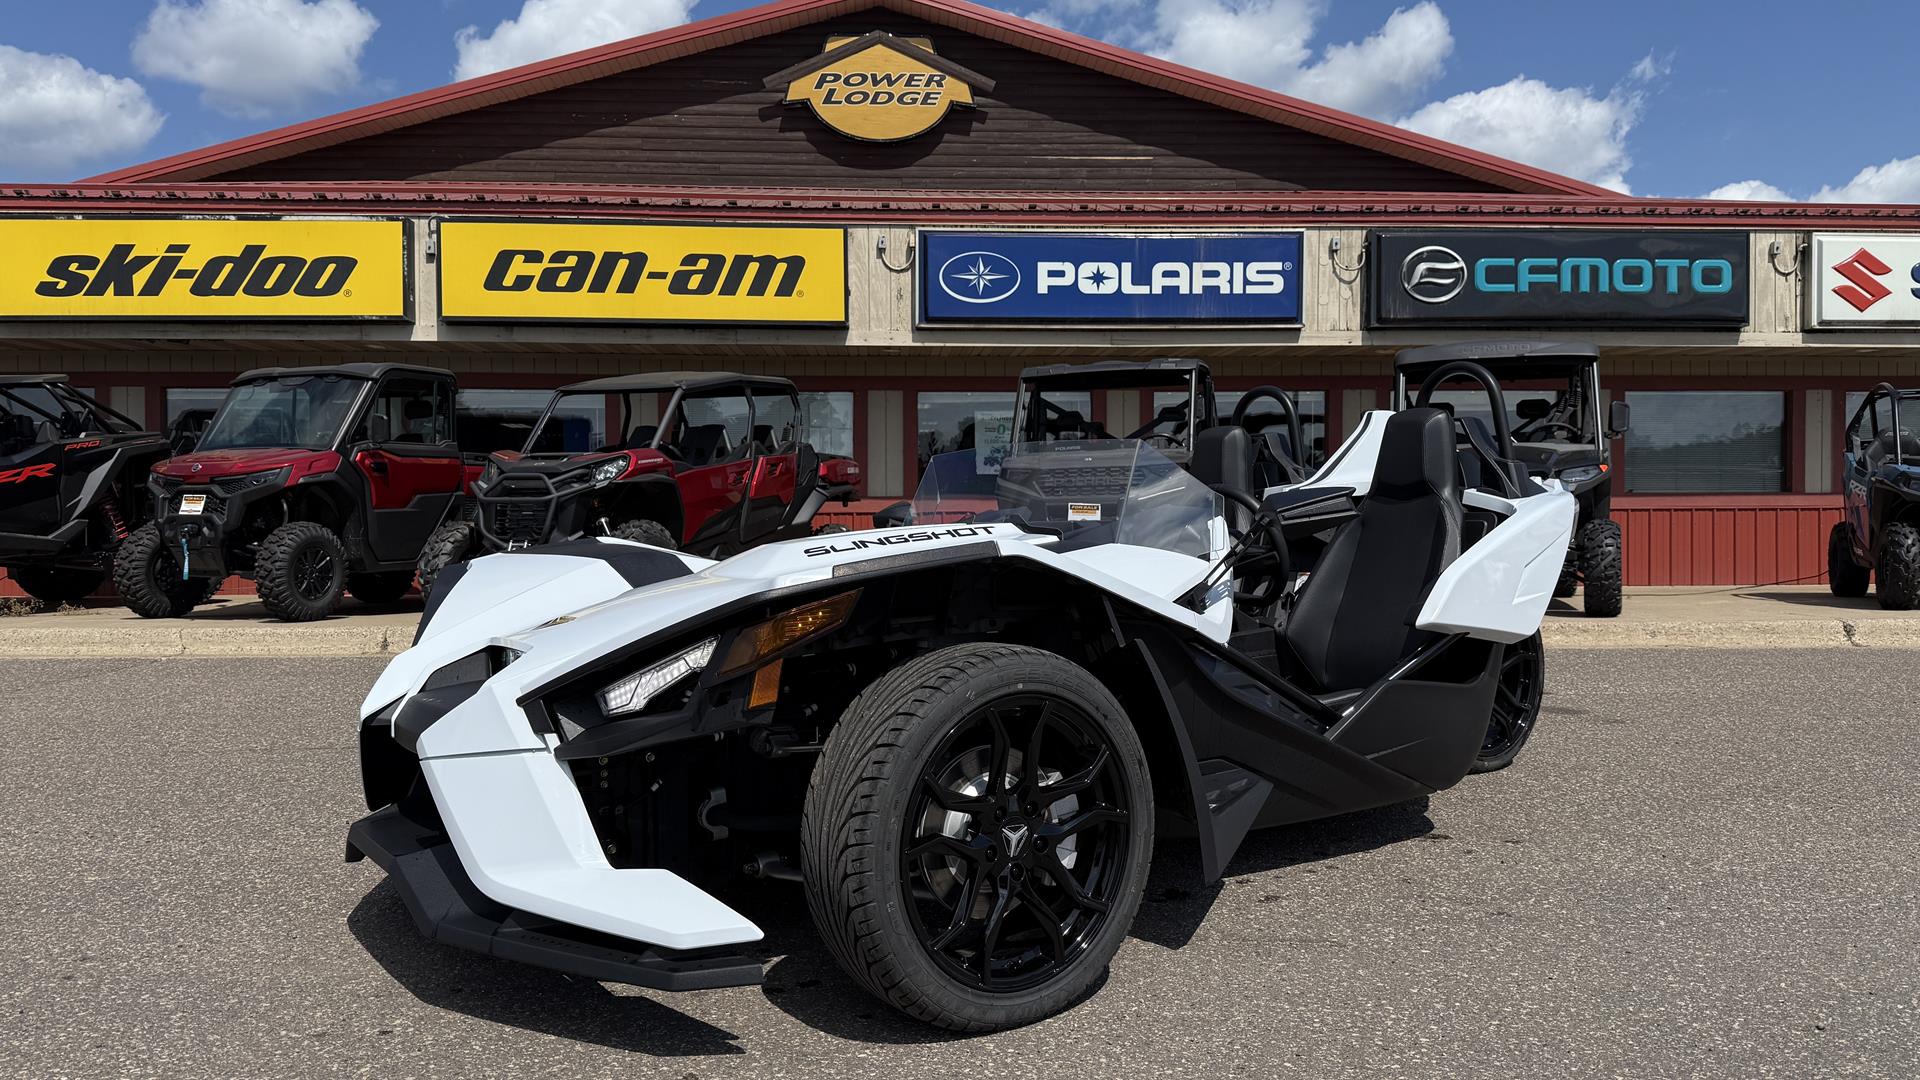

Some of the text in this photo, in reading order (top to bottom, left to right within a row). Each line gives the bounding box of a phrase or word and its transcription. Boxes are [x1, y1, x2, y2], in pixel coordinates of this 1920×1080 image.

[814, 72, 948, 90] POWER
[821, 88, 942, 106] LODGE
[35, 243, 358, 297] ski-doo
[483, 249, 806, 297] can-am
[1037, 261, 1285, 295] POLARIS
[1474, 257, 1733, 294] CFMOTO
[64, 440, 101, 451] PRO
[1849, 479, 1867, 501] RZR
[804, 526, 995, 558] SLINGSHOT
